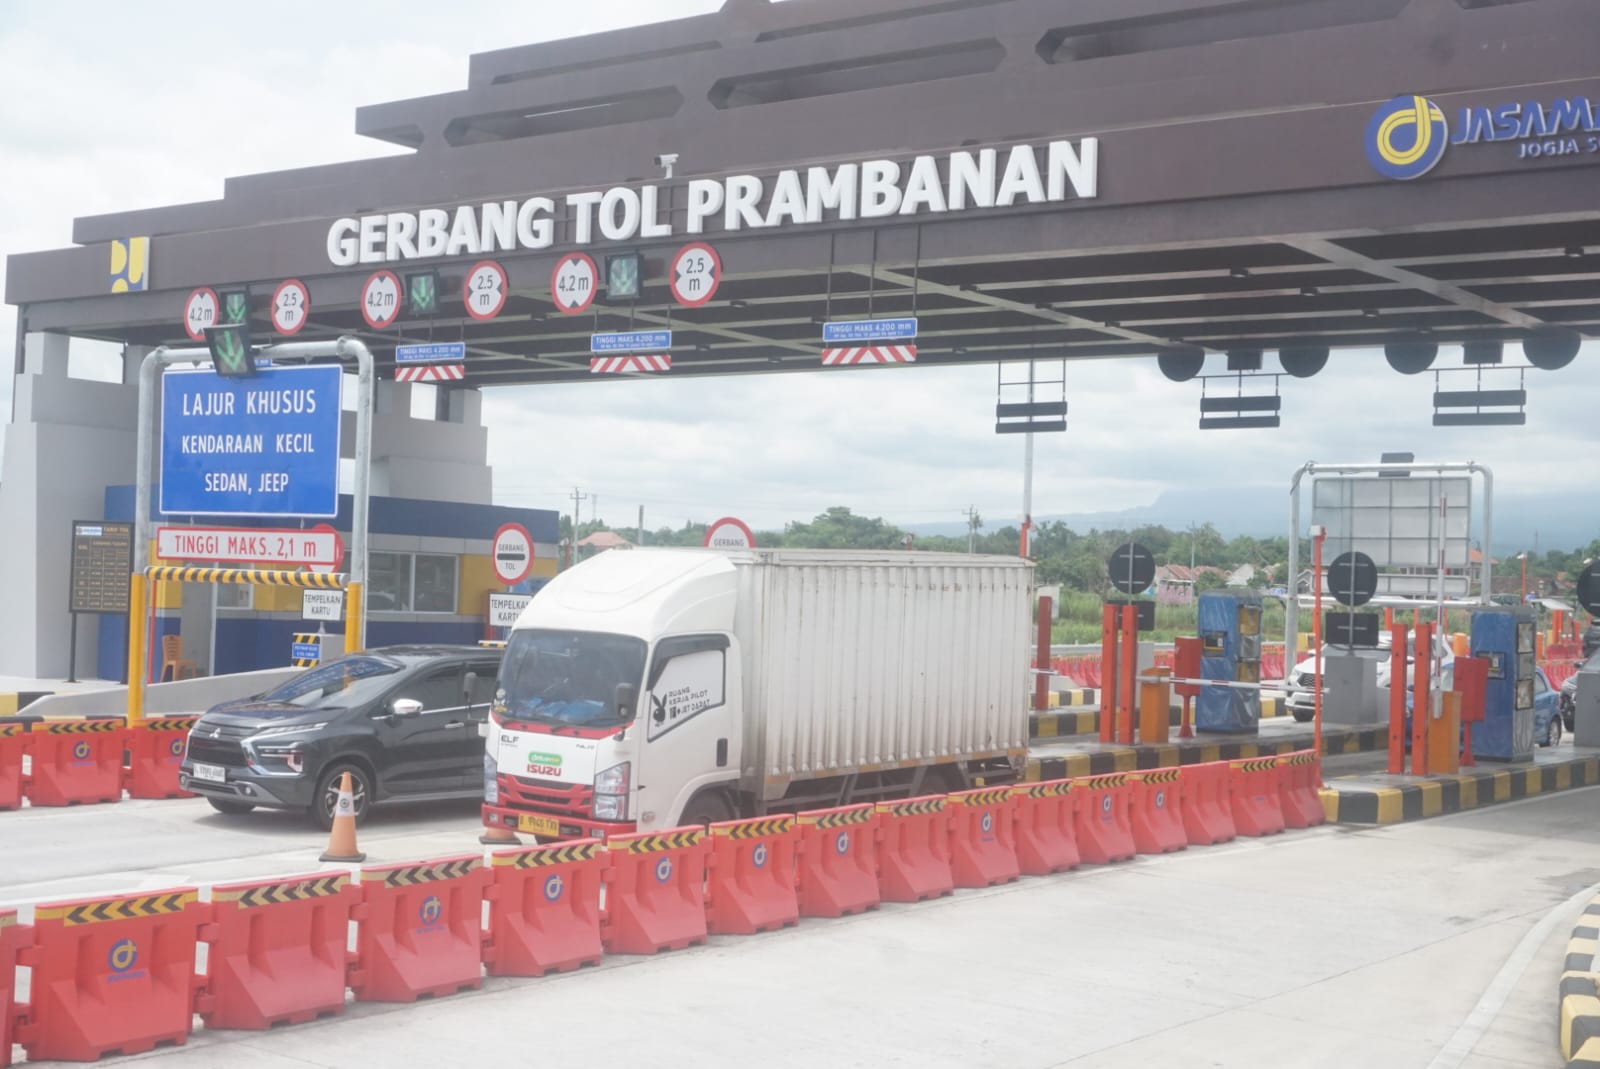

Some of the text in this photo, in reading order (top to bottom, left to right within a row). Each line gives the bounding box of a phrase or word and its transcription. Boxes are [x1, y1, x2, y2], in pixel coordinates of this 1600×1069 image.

[1452, 96, 1600, 144] JASAM
[1518, 138, 1600, 159] JOGJA S
[327, 137, 1098, 266] GERBANG TOL PRAMBANAN
[686, 258, 704, 274] 2.5
[478, 275, 493, 290] 2.5
[558, 275, 589, 292] 4.2 m
[688, 278, 700, 291] m
[283, 292, 297, 307] 2.5
[368, 292, 394, 307] 4.2 m
[480, 294, 490, 306] m
[190, 307, 213, 321] 4.2 m
[285, 310, 294, 321] m
[829, 325, 852, 333] TINGGI
[854, 324, 873, 332] MAKS
[182, 389, 316, 416] LAJUR KHUSUS
[182, 434, 314, 454] KENDARAAN KECIL
[204, 473, 289, 494] SEDAN, JEEP
[174, 535, 316, 560] TINGGI MAKS. 2,1 m
[498, 544, 524, 552] GERBANG
[714, 538, 744, 547] GERBANG
[505, 562, 516, 570] TOL
[304, 594, 340, 604] TEMPELKAN
[312, 606, 331, 616] KARTU
[690, 690, 708, 700] PILOT
[501, 734, 519, 744] ELF
[527, 764, 562, 776] ISUZU
